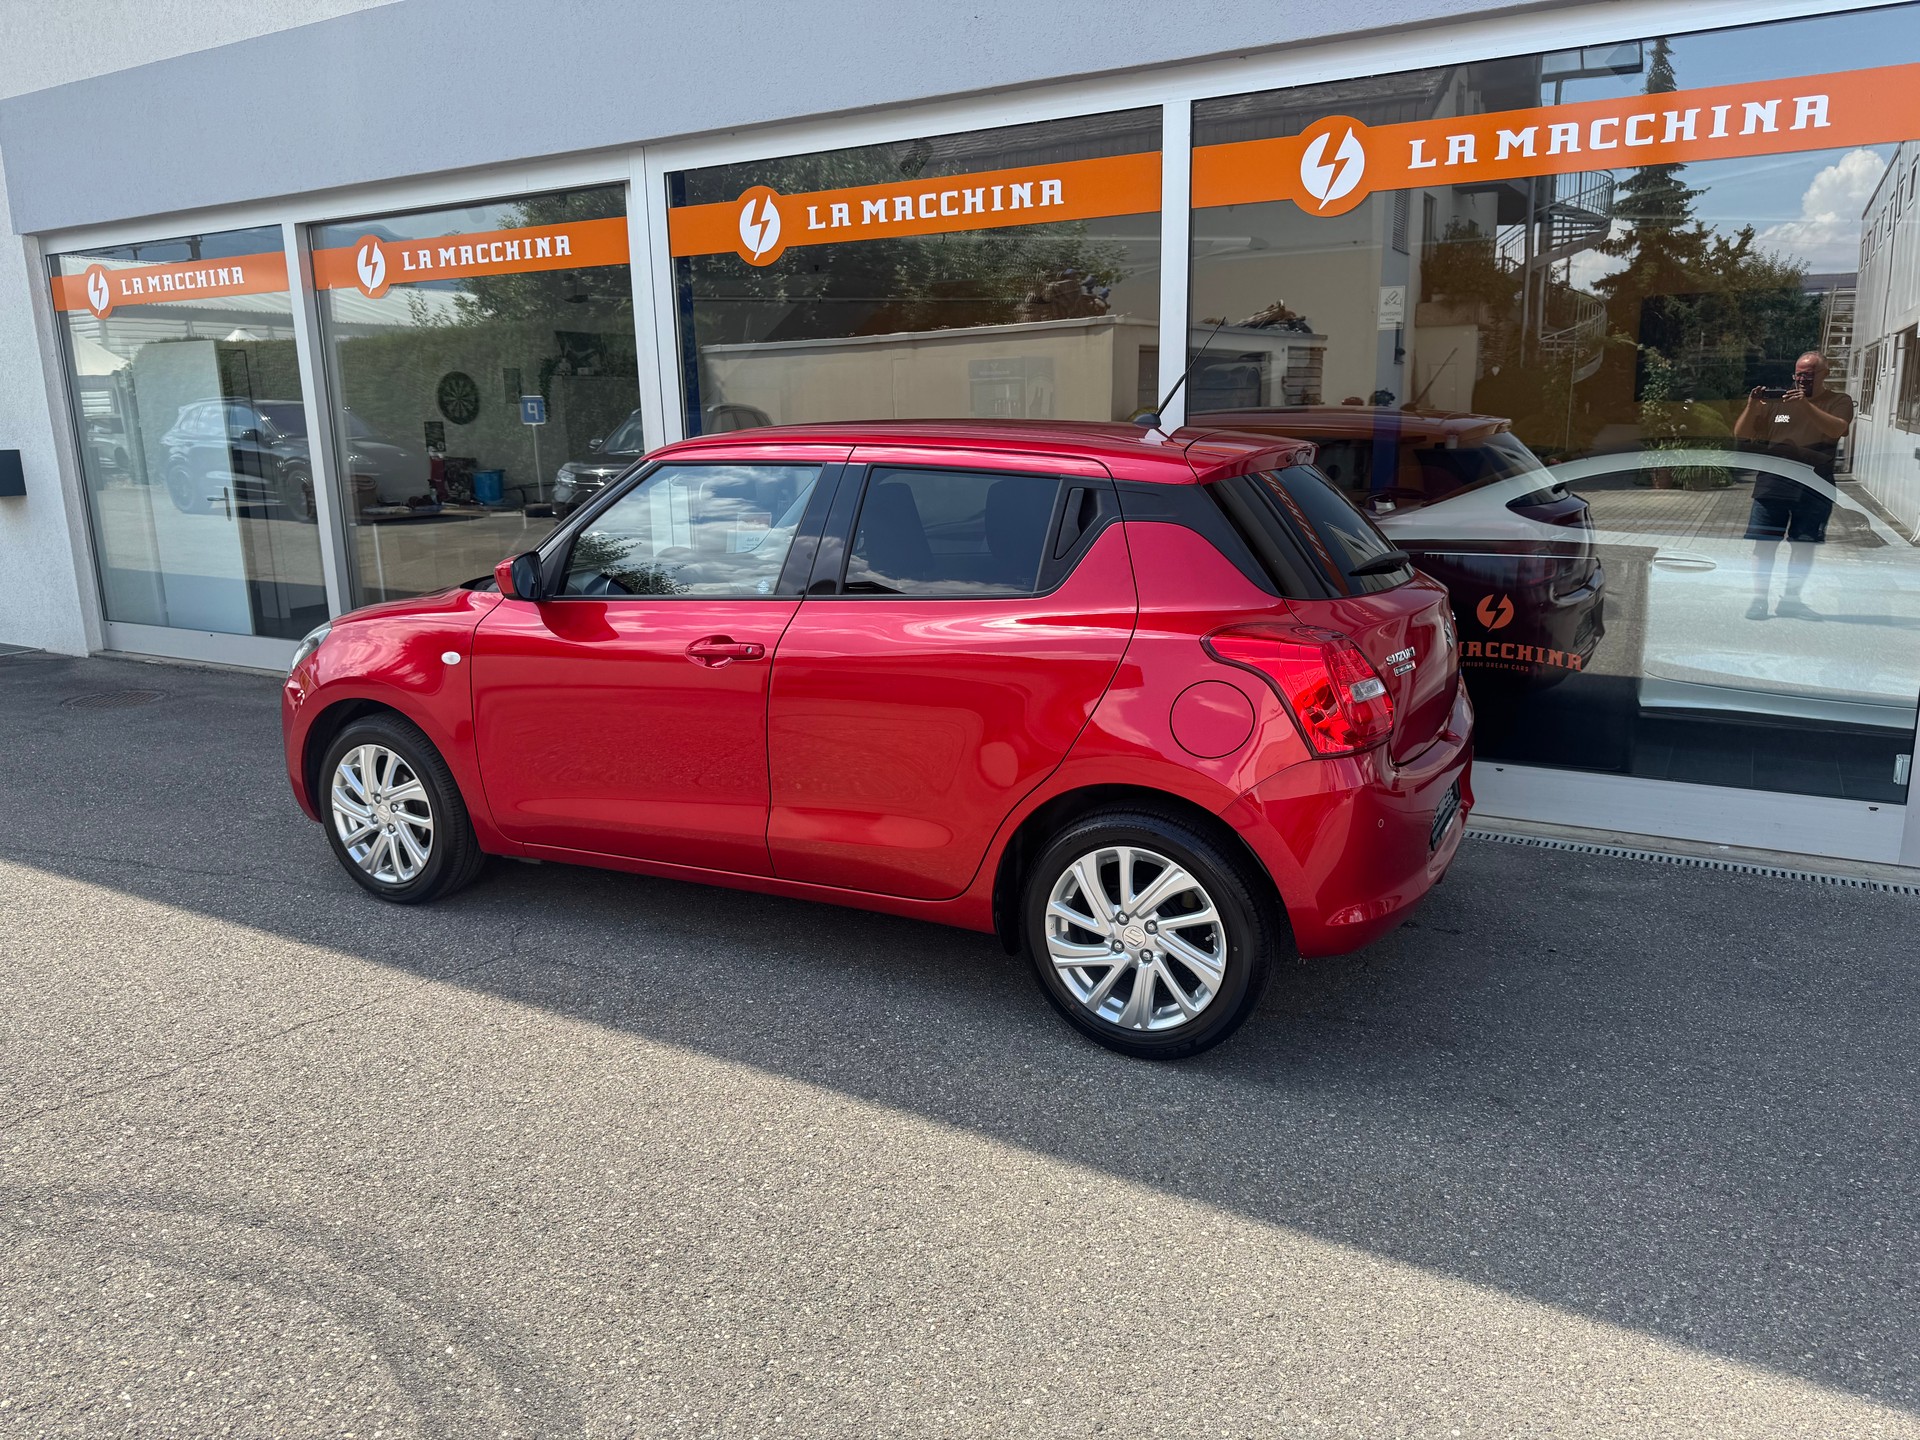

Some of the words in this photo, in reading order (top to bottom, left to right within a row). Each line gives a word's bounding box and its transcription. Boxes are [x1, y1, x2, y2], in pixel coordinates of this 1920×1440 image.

[1407, 133, 1478, 170] LA
[1494, 93, 1832, 161] MACCHINA
[806, 202, 852, 230] LA
[860, 178, 1065, 225] MACCHINA
[401, 248, 434, 271] LA
[437, 235, 572, 268] MACCHINA
[120, 276, 143, 296] LA
[146, 266, 245, 295] MACCHINA
[1385, 646, 1416, 666] SUZUKI
